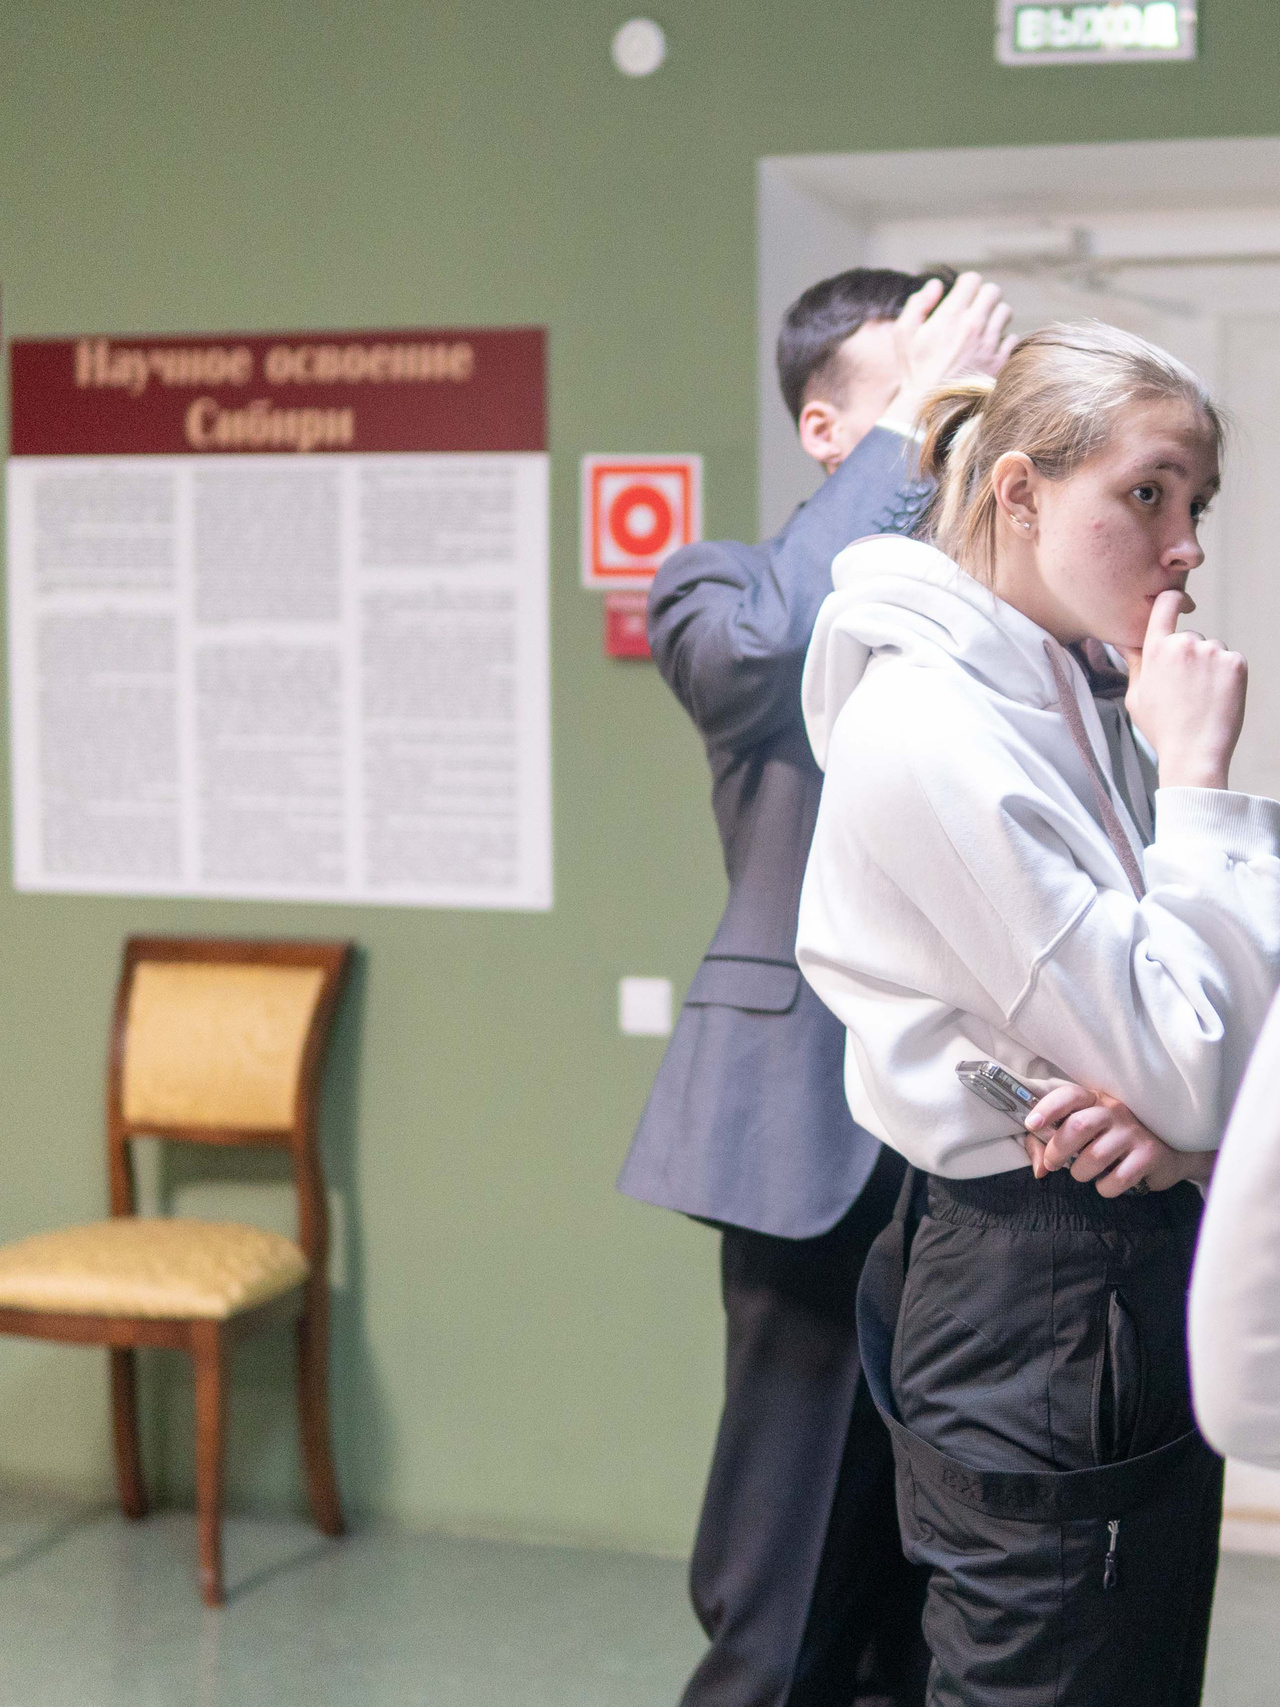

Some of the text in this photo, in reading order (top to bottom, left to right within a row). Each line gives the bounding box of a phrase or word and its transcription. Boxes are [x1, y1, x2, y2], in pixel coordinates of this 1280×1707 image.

[1017, 4, 1178, 48] ВЫХОД
[75, 338, 474, 393] Научное освоение
[185, 398, 355, 450] Сибири
